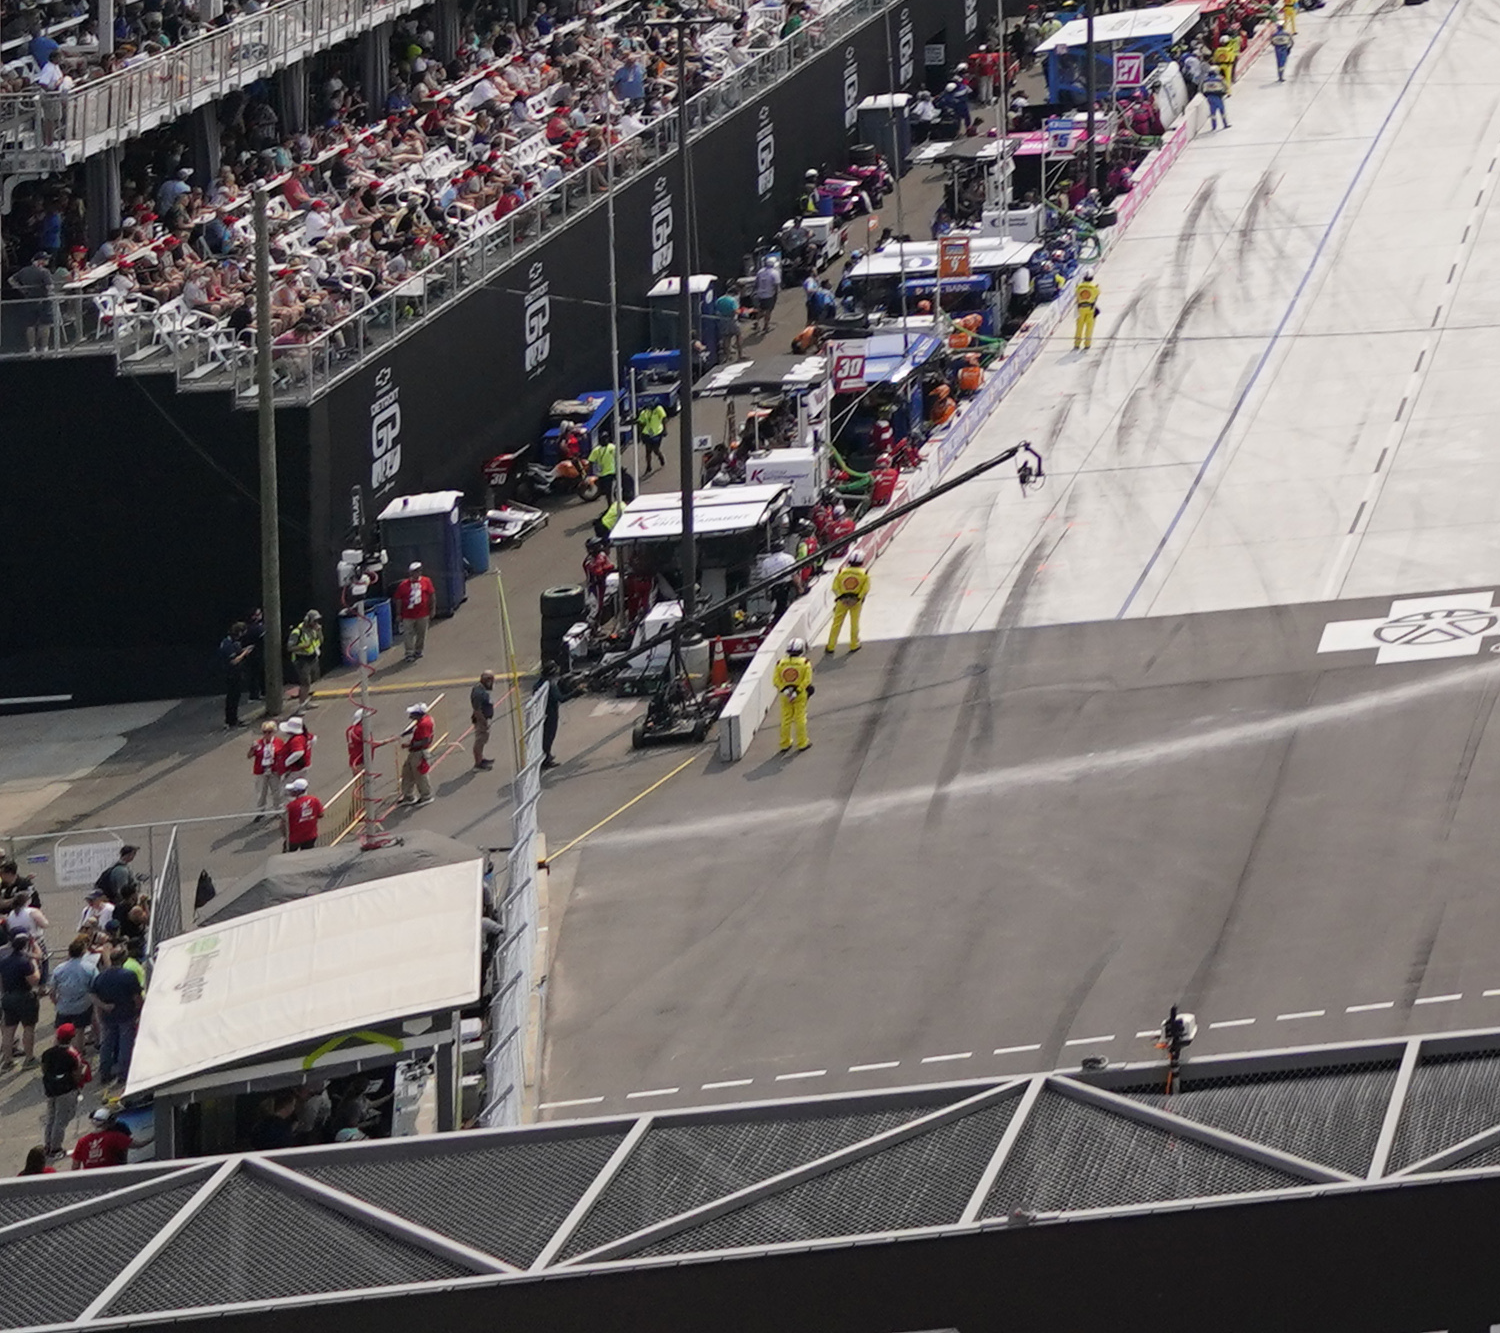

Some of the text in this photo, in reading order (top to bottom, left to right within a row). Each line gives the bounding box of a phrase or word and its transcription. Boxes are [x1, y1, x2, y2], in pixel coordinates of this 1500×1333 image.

[1118, 59, 1141, 81] 27
[652, 206, 673, 251] GP
[525, 294, 550, 346] GP
[837, 359, 861, 379] 30
[372, 403, 401, 459] GP
